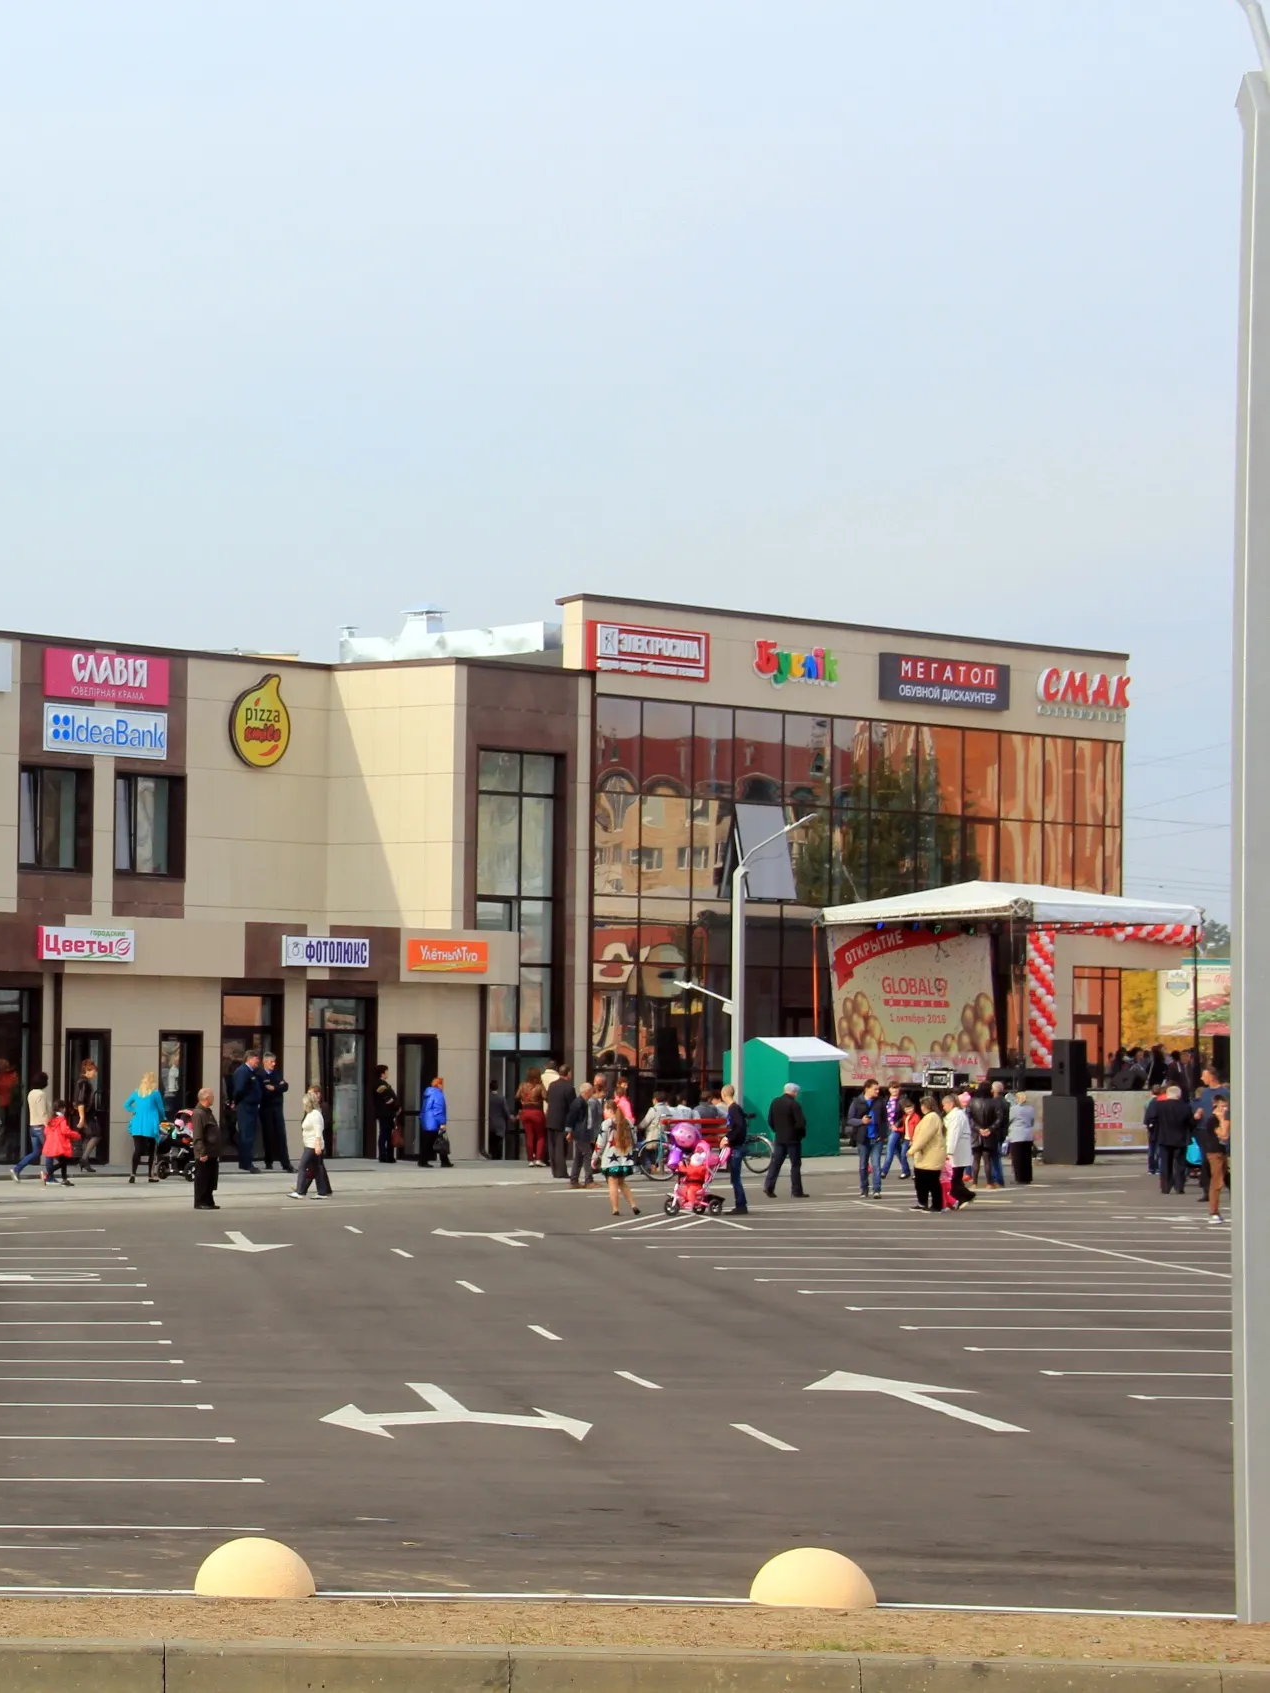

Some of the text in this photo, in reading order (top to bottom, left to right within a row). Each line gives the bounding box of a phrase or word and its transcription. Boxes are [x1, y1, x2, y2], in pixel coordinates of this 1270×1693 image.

[71, 653, 148, 688] СЛАВІЯ
[901, 660, 995, 686] МЕГАТОП
[118, 690, 145, 700] КРАМА
[898, 684, 997, 704] ОБУВНОЙ ДИСКАУНТЕР
[1036, 667, 1131, 709] СМАК
[245, 707, 281, 725] pizza
[71, 715, 165, 749] IdeaBank
[45, 934, 114, 956] Цветы
[305, 940, 368, 965] ФОТОЛЮКС
[844, 929, 904, 965] ОТКРЫТИЕ
[881, 976, 936, 996] GLOBAL
